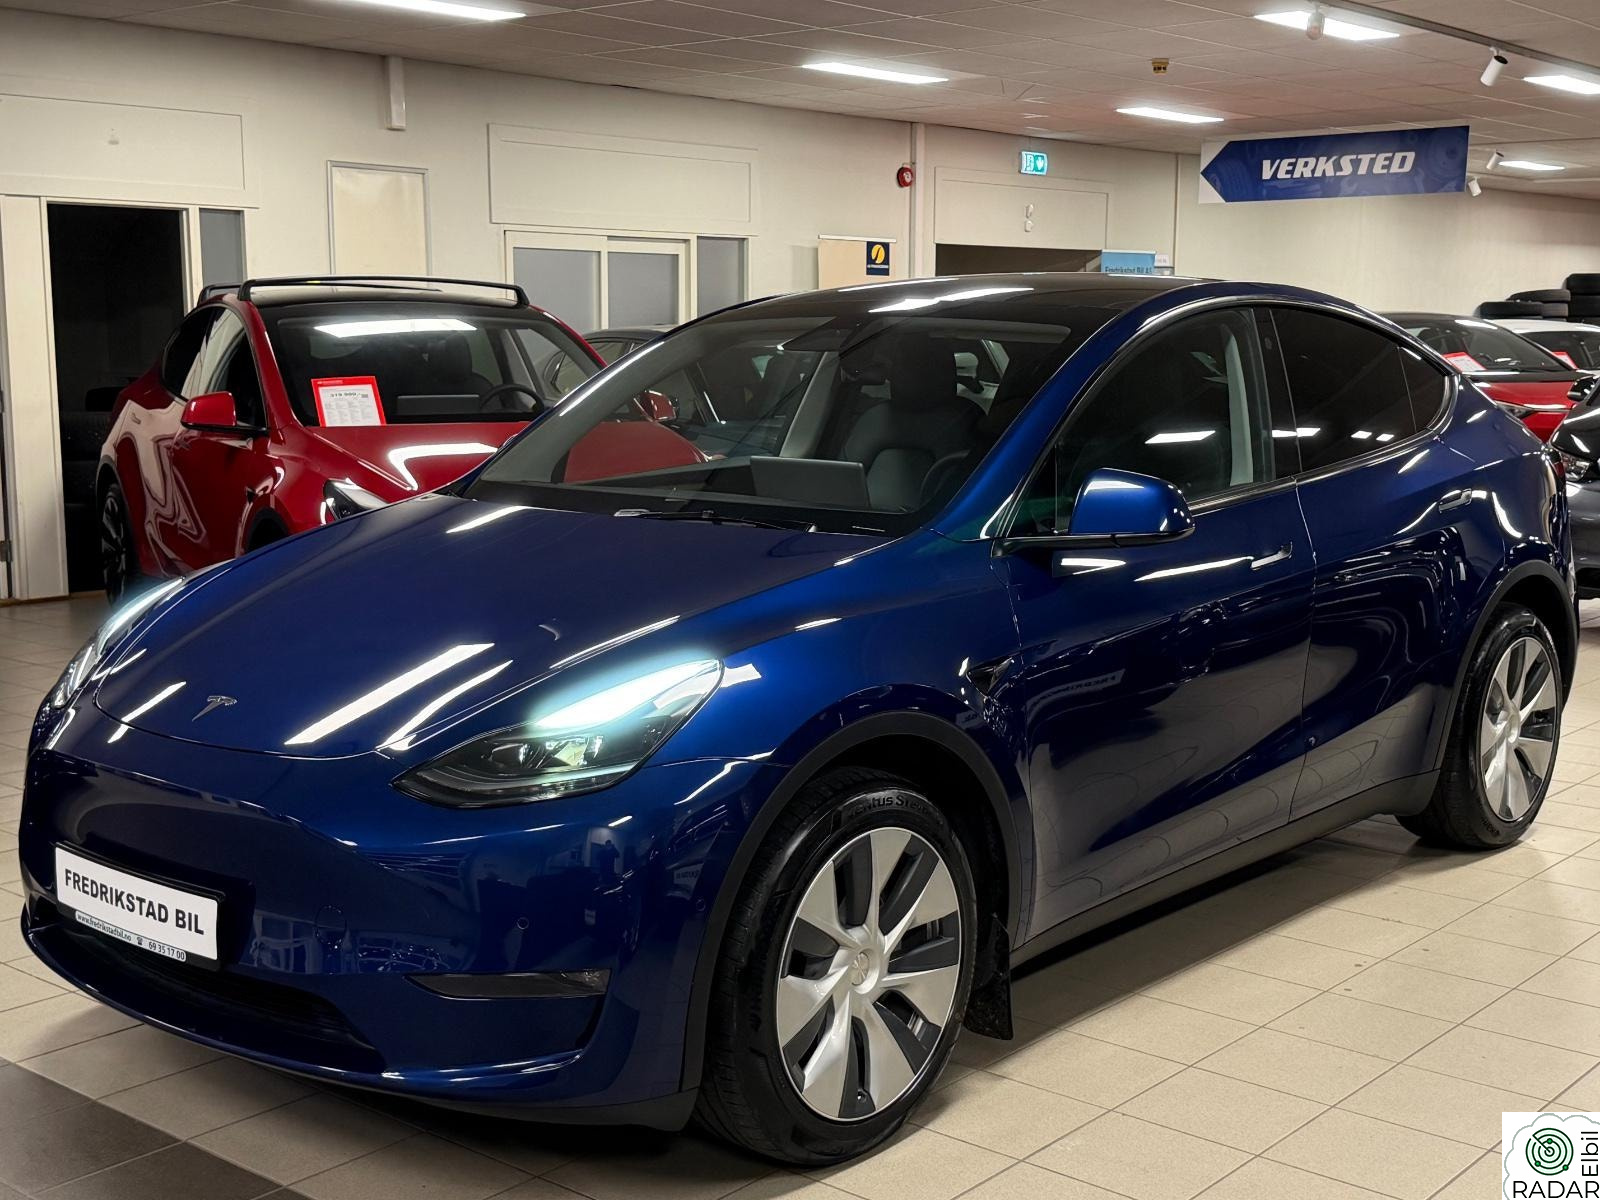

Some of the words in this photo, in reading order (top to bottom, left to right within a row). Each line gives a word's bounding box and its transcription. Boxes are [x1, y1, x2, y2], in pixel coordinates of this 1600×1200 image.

[1261, 151, 1415, 180] VERKSTED
[64, 868, 169, 924] FREDRIKSTAD
[175, 908, 204, 936] BIL
[77, 914, 132, 942] www.fredrikstadbil.no
[148, 941, 158, 951] 69
[158, 944, 167, 954] 35
[167, 947, 176, 957] 17
[176, 951, 186, 961] 00
